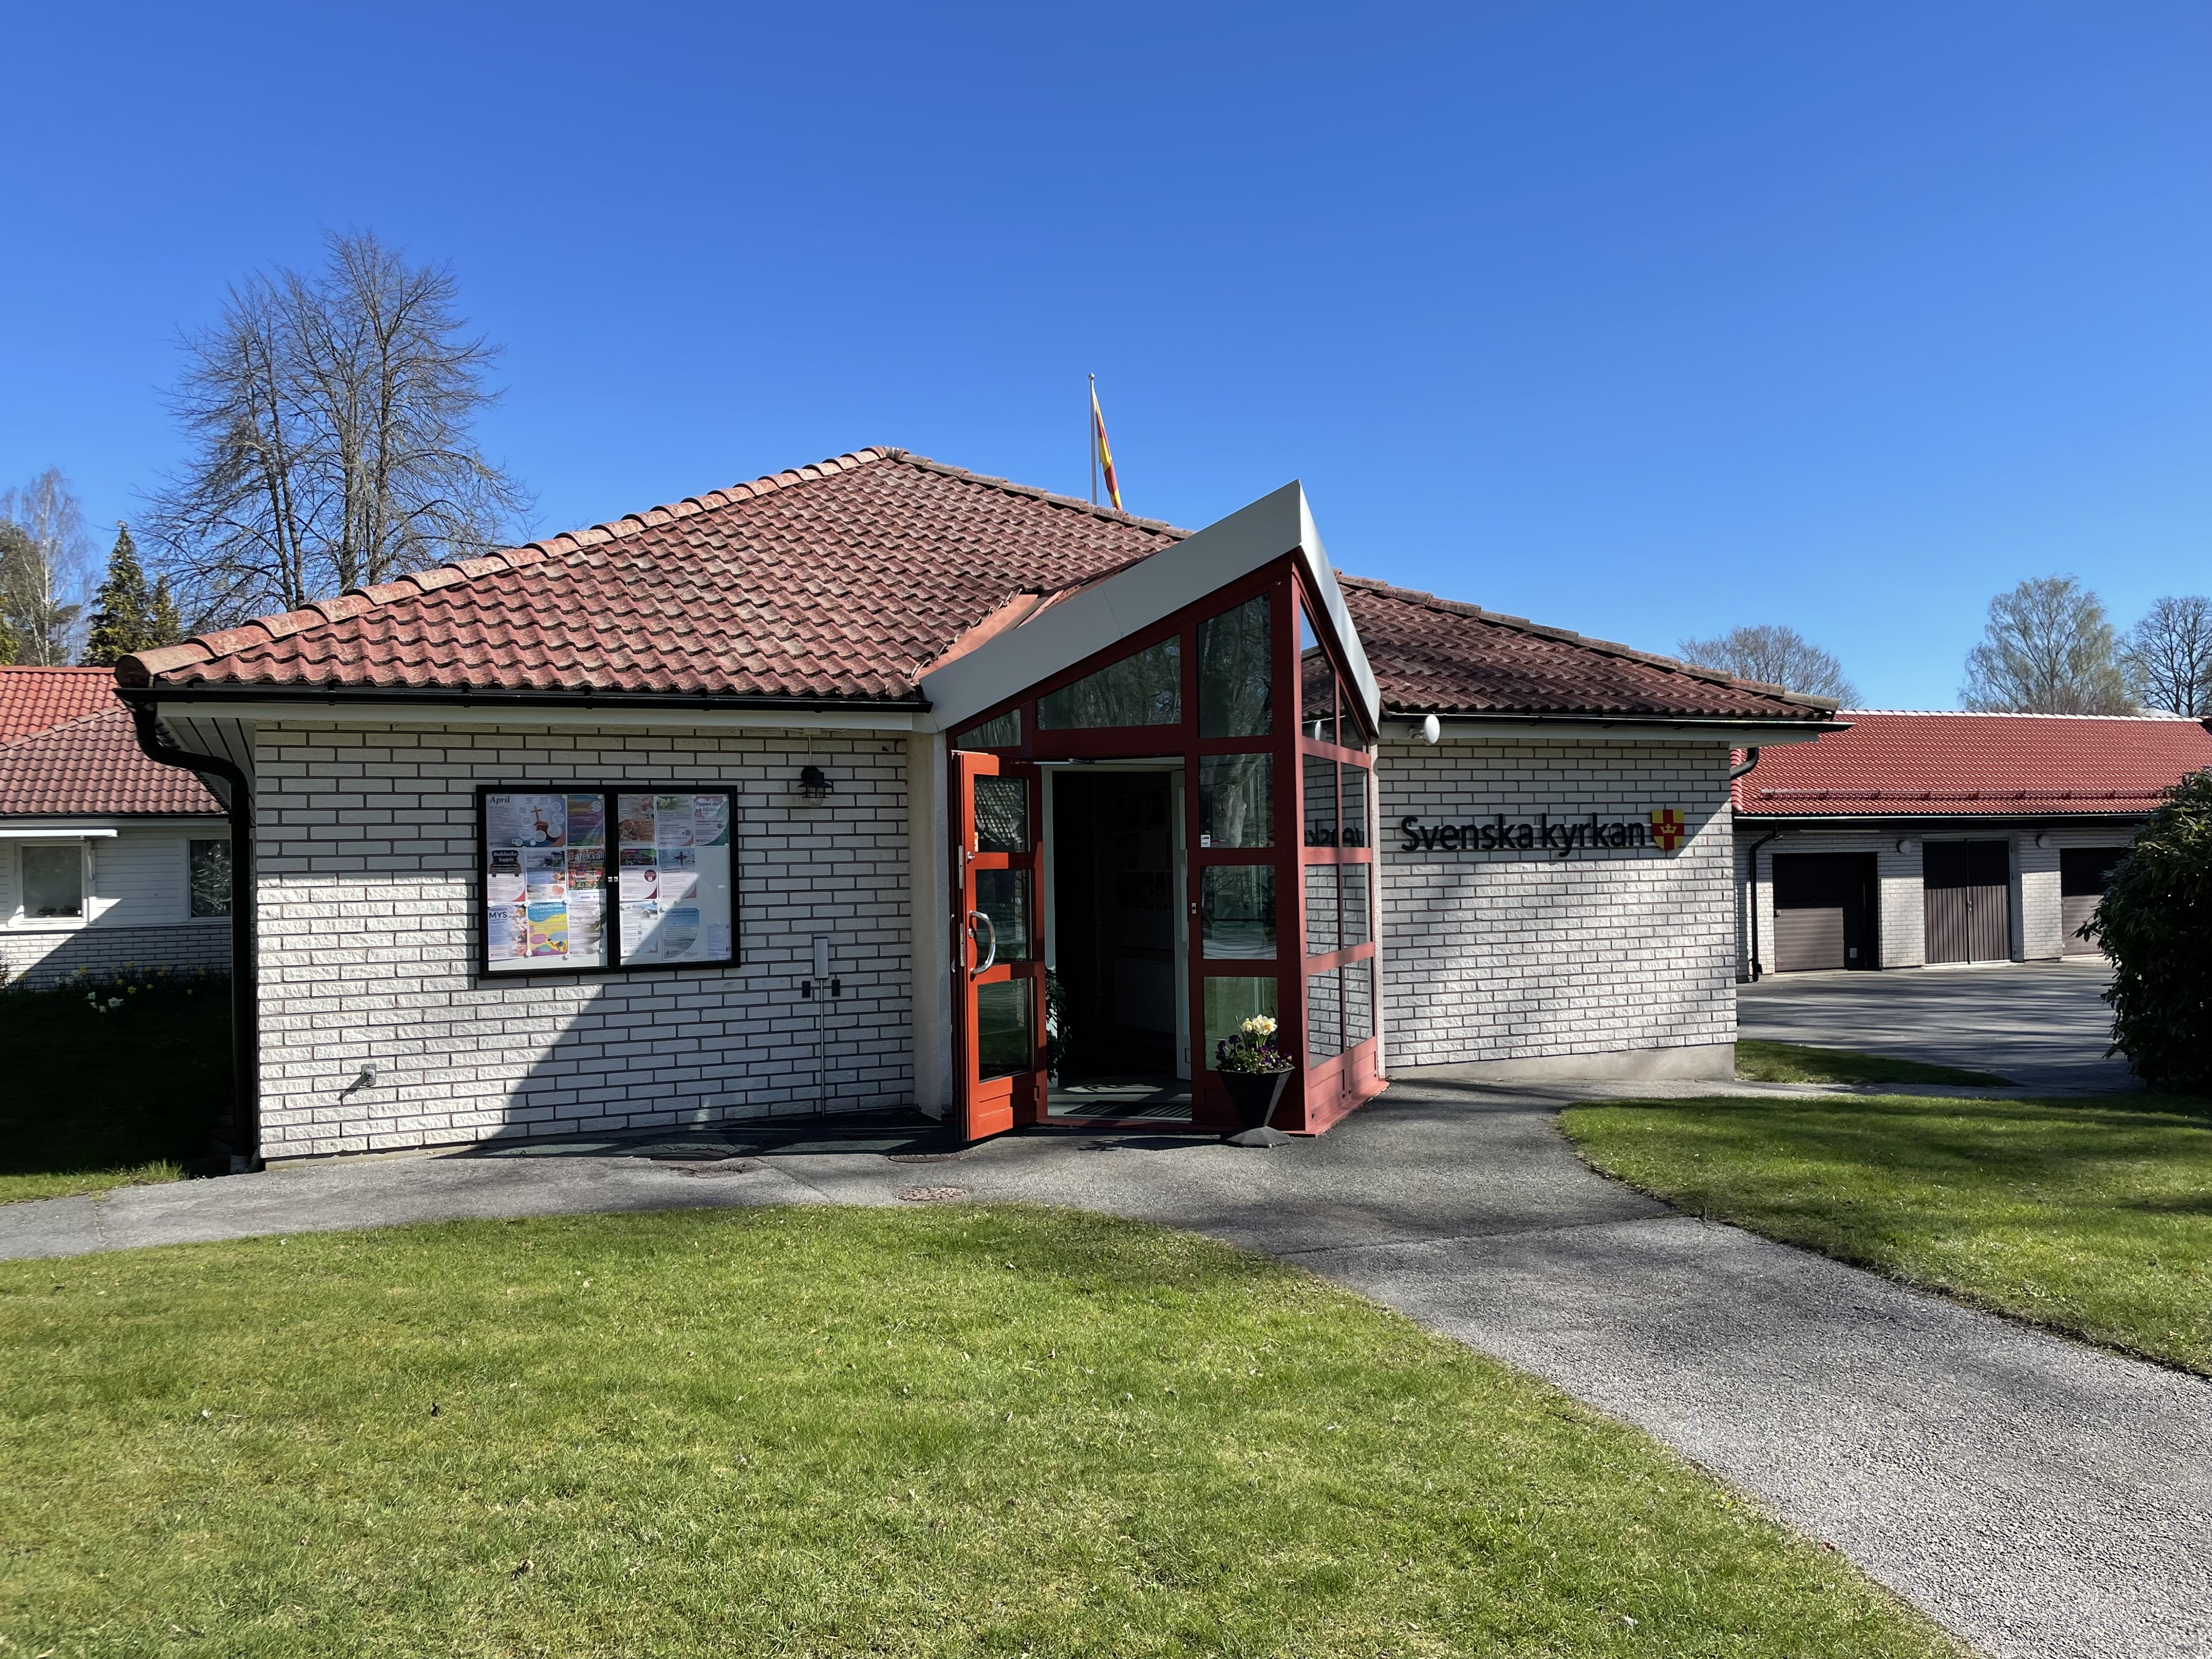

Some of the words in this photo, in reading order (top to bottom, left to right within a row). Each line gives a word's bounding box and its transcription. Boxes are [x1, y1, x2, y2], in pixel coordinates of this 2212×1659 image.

[489, 795, 510, 804] April
[1401, 813, 1534, 851] Svenska
[1541, 812, 1645, 857] kyrkan
